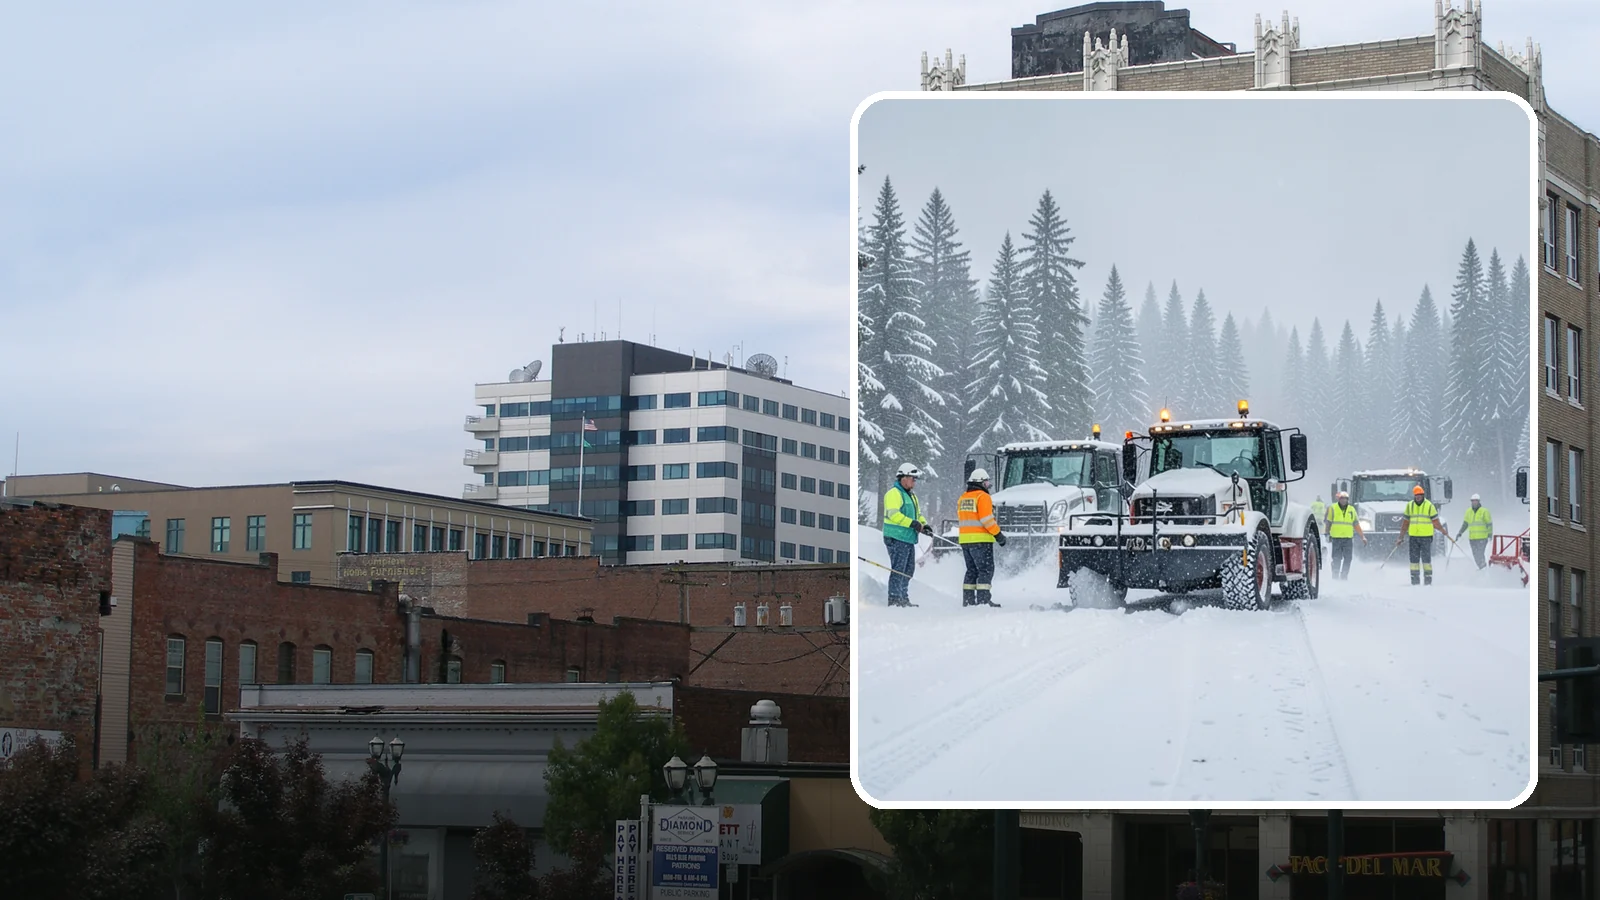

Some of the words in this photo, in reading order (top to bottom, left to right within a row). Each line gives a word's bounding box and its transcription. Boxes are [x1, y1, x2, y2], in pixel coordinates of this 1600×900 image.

[370, 566, 427, 576] Furnishers
[660, 818, 713, 832] DIAMOND
[1022, 815, 1069, 828] BUILDING
[617, 825, 625, 852] PAY
[628, 824, 636, 852] PAY
[655, 845, 688, 853] RESERVED
[689, 846, 716, 854] PARKING
[721, 851, 739, 861] Soup
[671, 862, 701, 870] PATRONS
[1346, 856, 1385, 875] DEL
[1392, 857, 1442, 876] MAR
[616, 856, 625, 893] HERE
[627, 856, 636, 893] HERE
[660, 889, 682, 897] PUBLIC
[683, 889, 710, 898] PARKING
